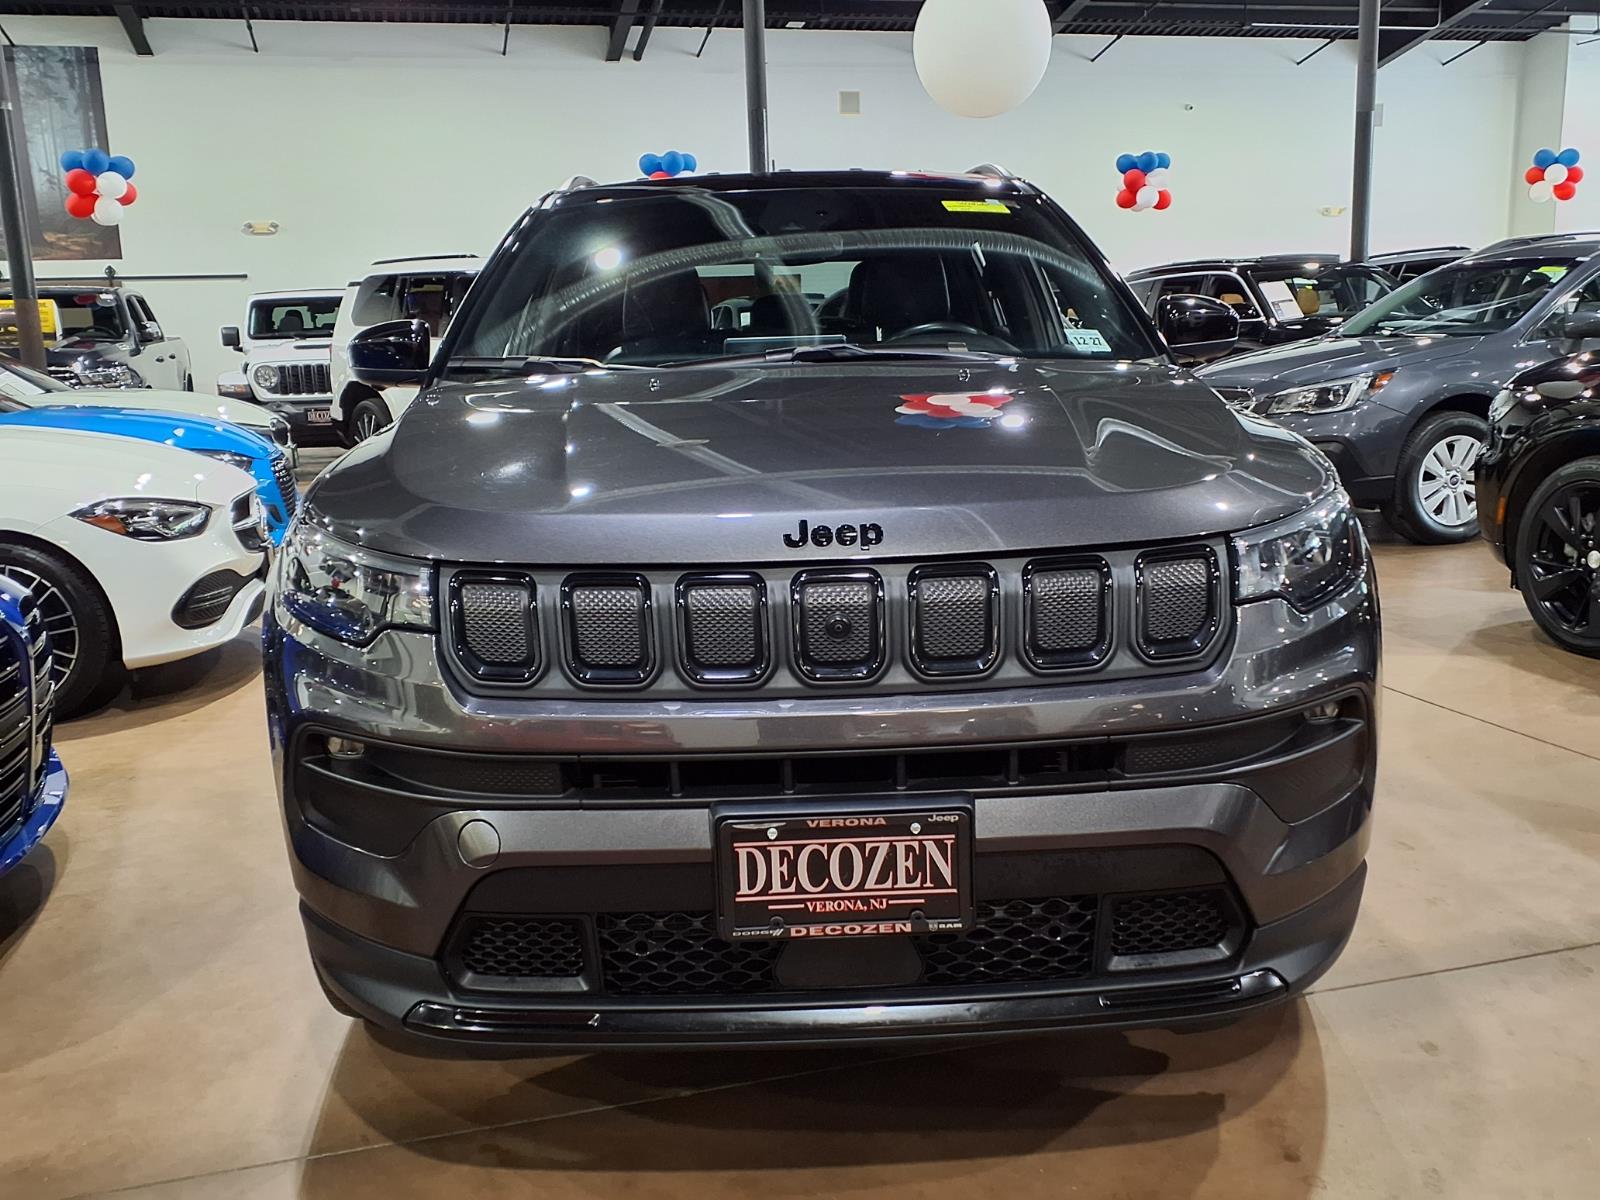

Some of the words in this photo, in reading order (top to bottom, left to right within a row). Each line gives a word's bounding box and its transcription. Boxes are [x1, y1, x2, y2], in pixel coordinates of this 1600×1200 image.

[783, 519, 884, 551] Jeep
[806, 817, 887, 828] VERONA
[927, 814, 959, 823] Jeep
[735, 840, 954, 895] DECOZEN
[806, 900, 868, 913] VERONA,
[870, 898, 889, 910] NJ
[790, 922, 912, 937] DECOZEN
